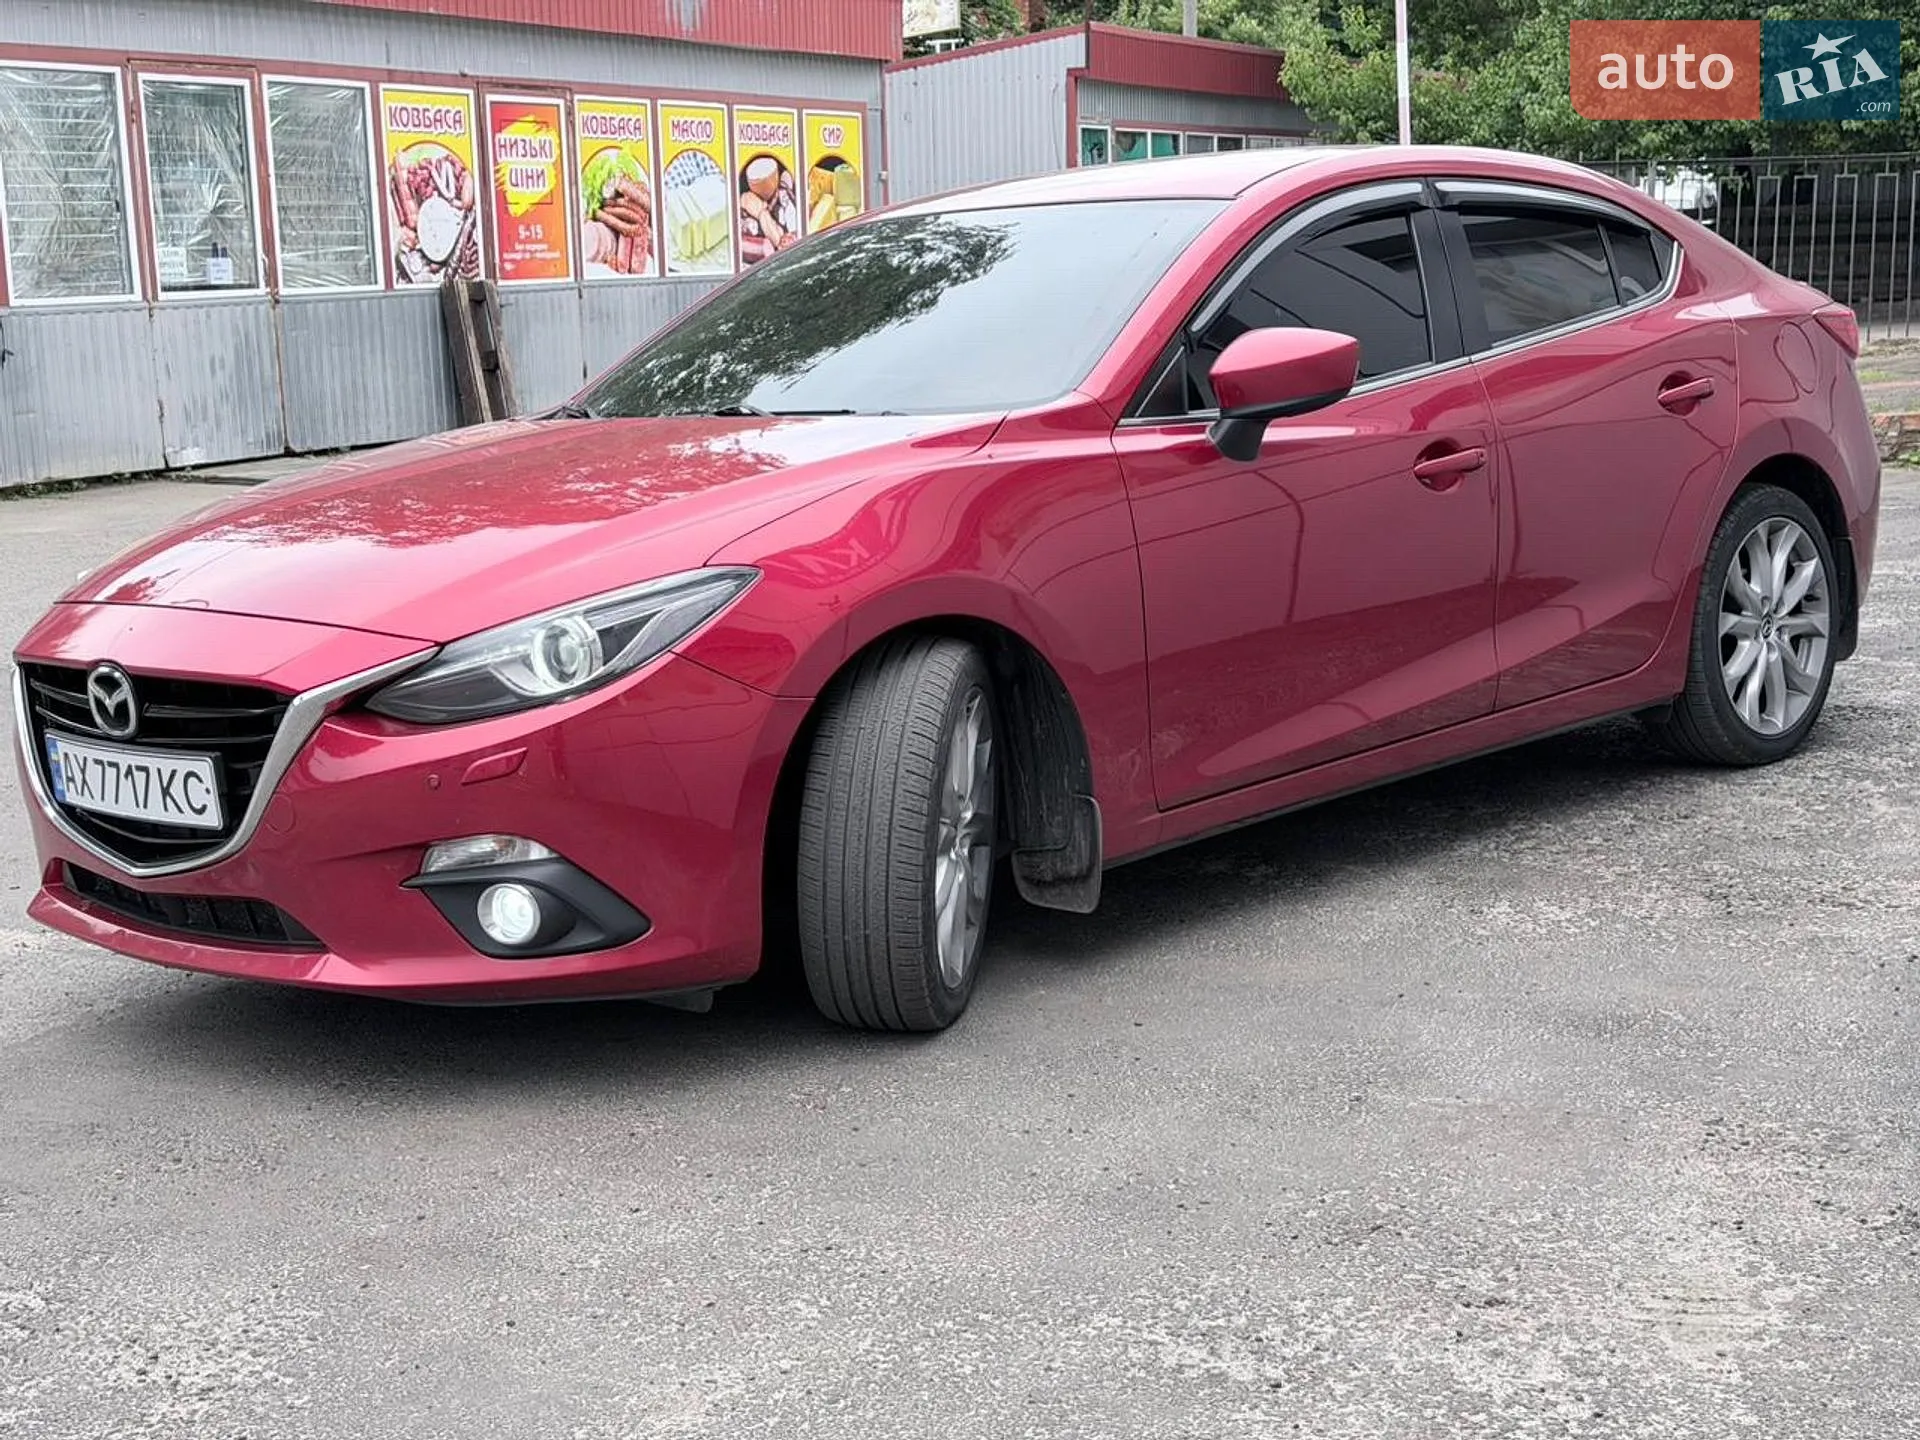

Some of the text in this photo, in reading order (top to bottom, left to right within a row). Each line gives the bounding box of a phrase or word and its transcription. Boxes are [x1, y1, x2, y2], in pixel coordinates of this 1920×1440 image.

[387, 105, 465, 131] КОВБАСА
[581, 114, 643, 137] КОВБАСА
[671, 119, 713, 140] МАСЛО
[738, 124, 790, 144] КОВБАСА
[822, 126, 844, 144] СИР
[497, 137, 554, 159] НИЗЬКІ
[509, 167, 546, 189] ЦІНИ
